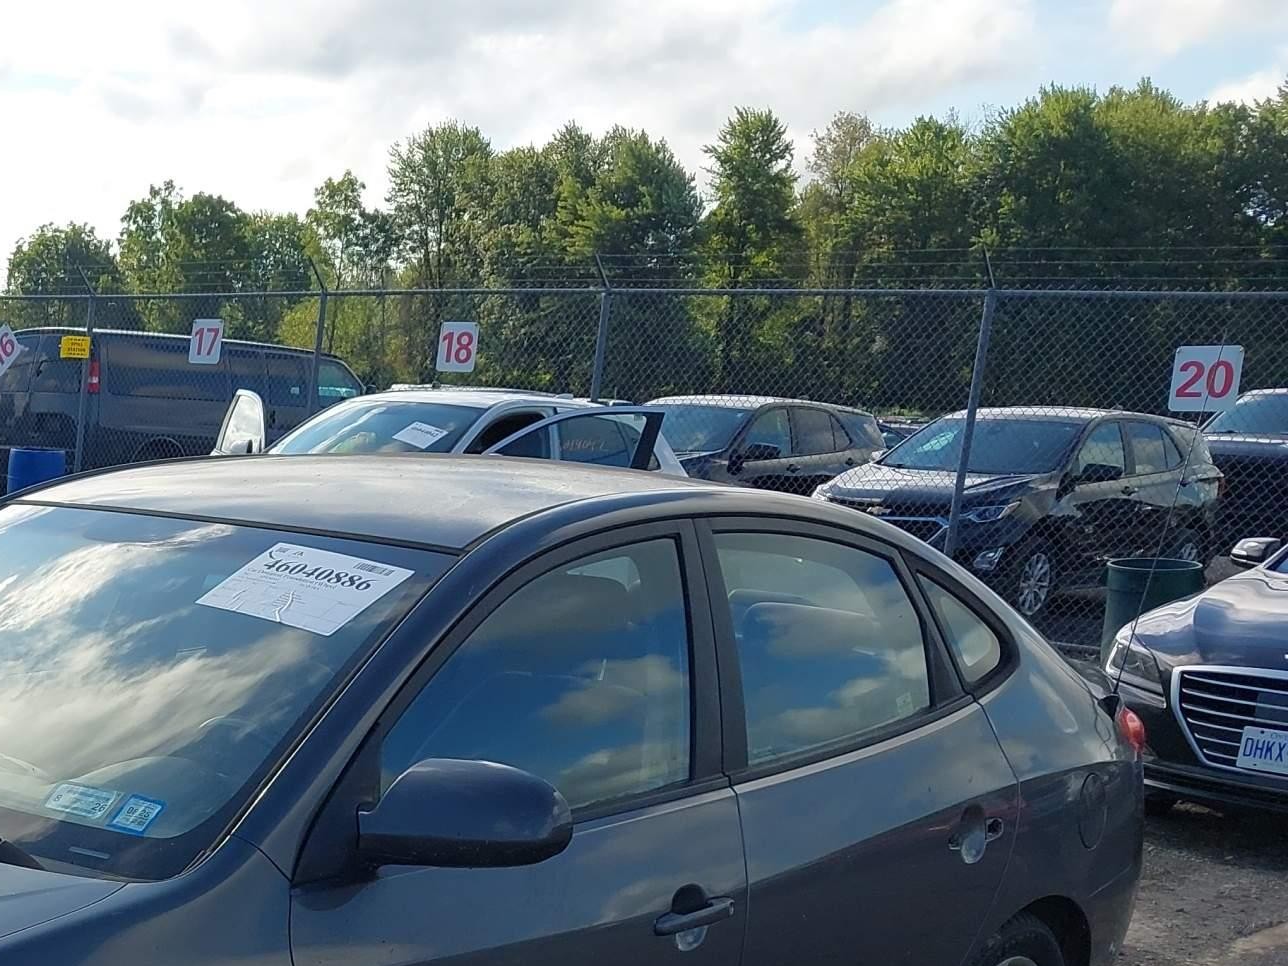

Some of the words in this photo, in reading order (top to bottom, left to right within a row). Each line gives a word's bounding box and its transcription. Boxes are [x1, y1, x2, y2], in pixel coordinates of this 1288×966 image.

[195, 327, 220, 356] 17
[442, 331, 474, 364] 18
[1176, 360, 1234, 399] 20
[263, 559, 376, 592] 46040886
